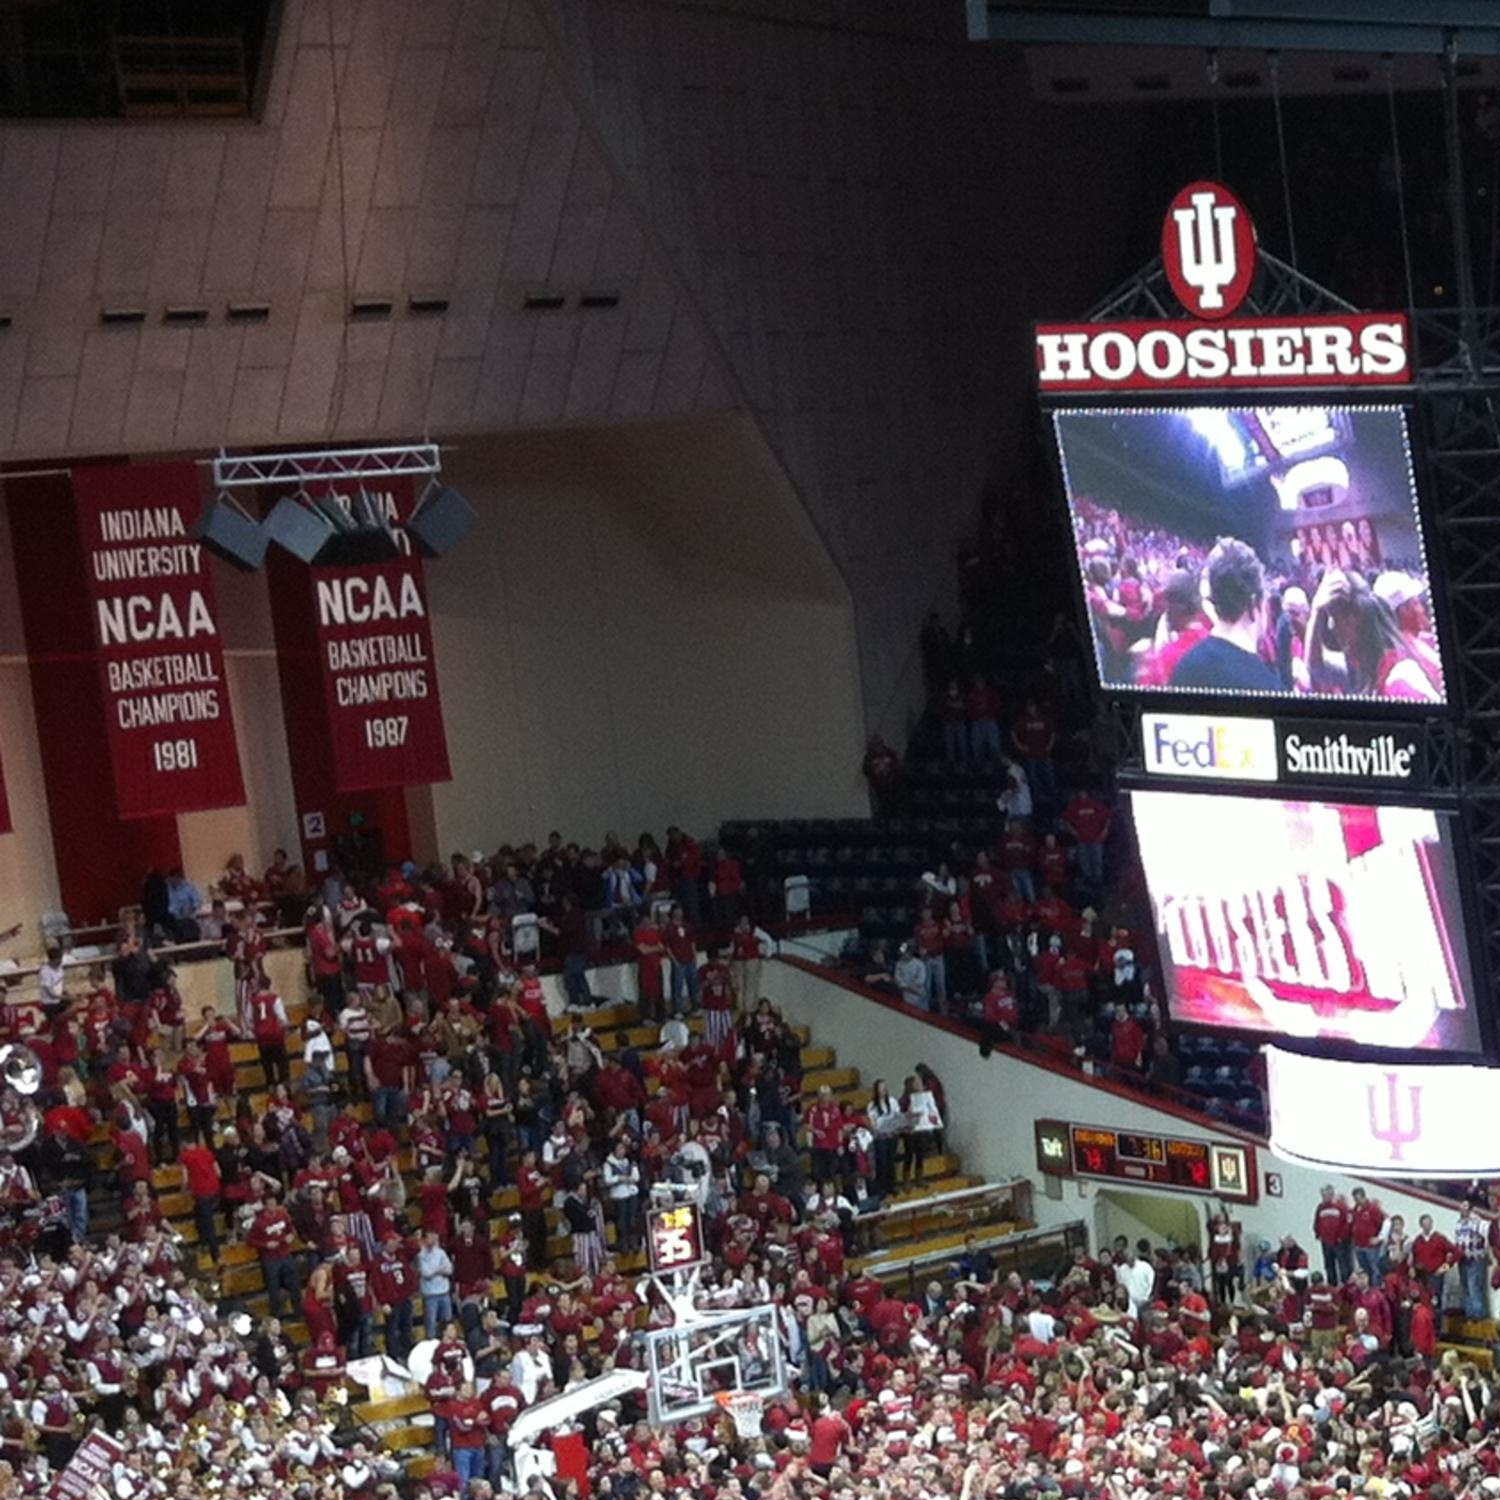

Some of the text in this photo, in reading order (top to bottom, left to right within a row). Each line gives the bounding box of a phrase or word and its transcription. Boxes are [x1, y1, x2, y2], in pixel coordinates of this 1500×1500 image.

[1037, 323, 1407, 381] HOOSIERS
[100, 506, 186, 541] INDIANA
[92, 543, 201, 580] UNIVERSITY
[97, 590, 216, 645] NCAA
[317, 572, 425, 626] NCAA
[327, 633, 428, 671] BASKETBALL
[108, 652, 219, 692] BASKETBALL
[117, 689, 219, 729] CHAMPIONS
[366, 716, 408, 749] 1987
[1153, 722, 1255, 769] FedEx
[153, 738, 198, 772] 1981
[1269, 1174, 1282, 1195] 3
